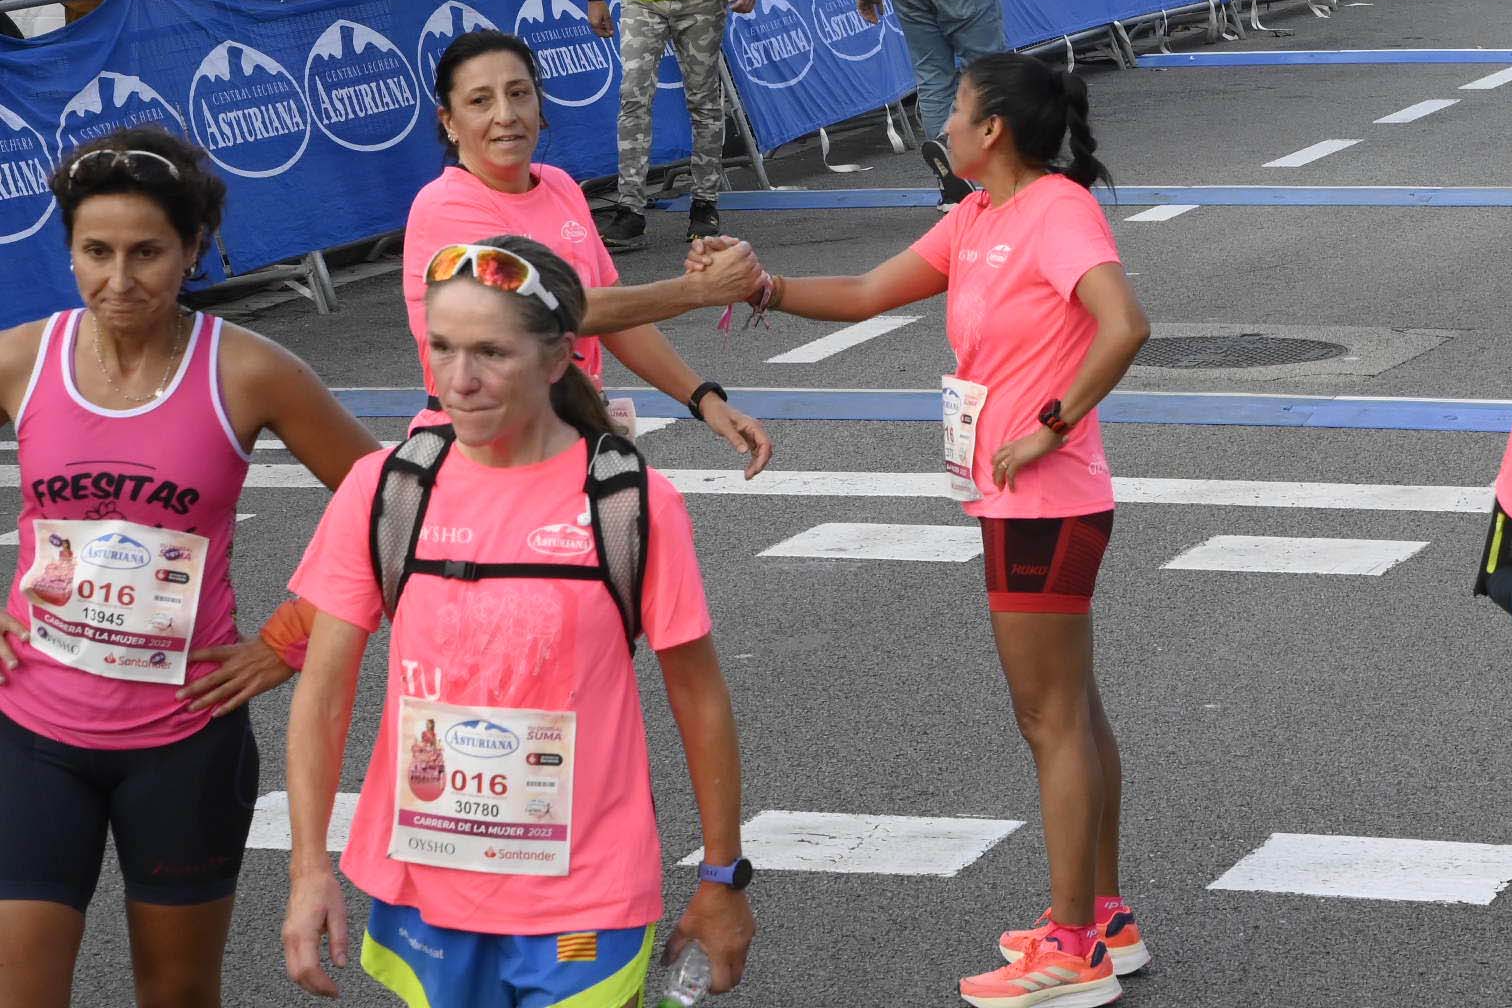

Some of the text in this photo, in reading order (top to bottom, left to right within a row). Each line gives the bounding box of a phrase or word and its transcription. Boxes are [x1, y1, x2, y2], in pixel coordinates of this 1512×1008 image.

[325, 57, 400, 83] CENTRAL LECHERA
[212, 81, 289, 106] CENTRAL LECHERA
[315, 75, 415, 125] ASTURIANA
[200, 97, 305, 151] ASTURIANA
[610, 410, 628, 418] UMA
[944, 424, 954, 443] 16
[32, 472, 200, 515] FRESITAS
[77, 579, 136, 607] 016
[82, 607, 125, 626] 13945
[96, 628, 108, 641] LA
[110, 633, 147, 645] MUJER
[402, 660, 443, 702] TU
[451, 731, 513, 751] ASTURIANA
[527, 730, 563, 741] SUMA
[451, 770, 508, 797] 016
[455, 800, 500, 818] 30780
[413, 816, 455, 830] CARRERA
[457, 822, 470, 831] DE
[473, 825, 486, 834] LA
[488, 827, 524, 837] MUJER
[408, 837, 556, 862] OYSHO Santander
